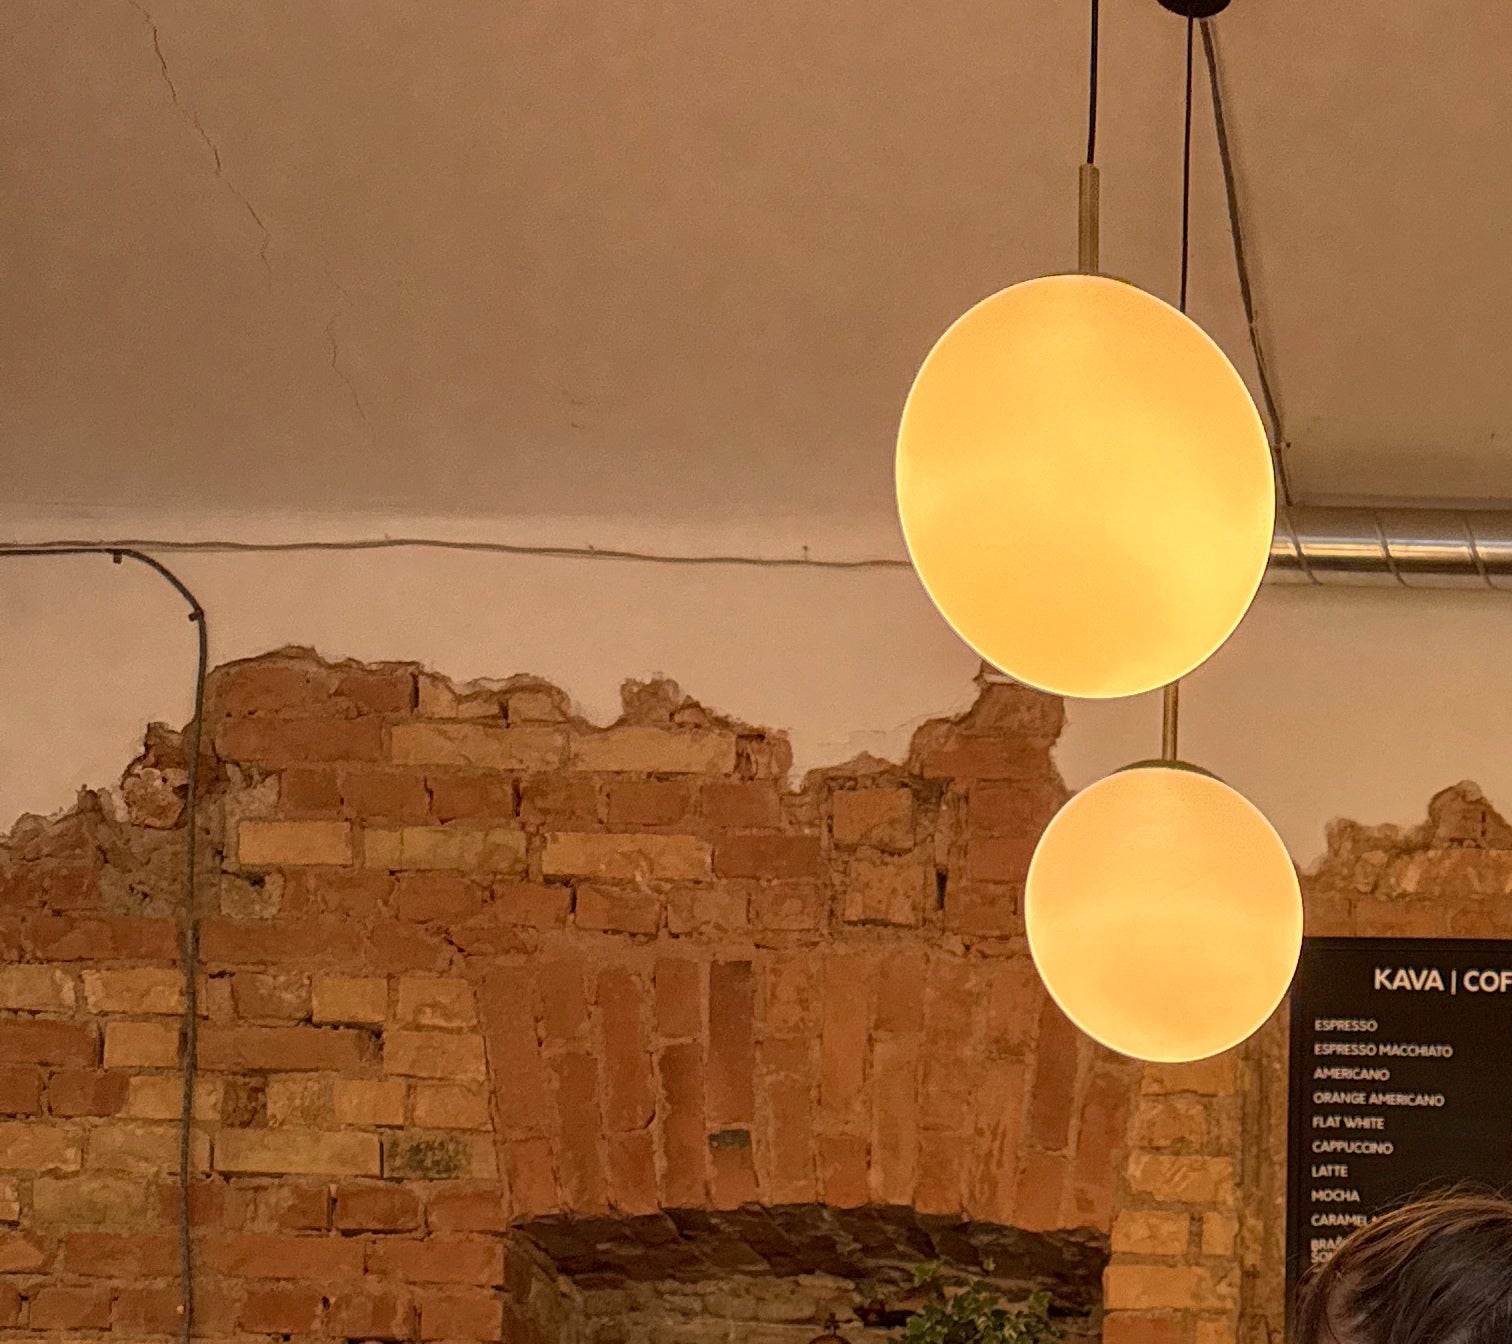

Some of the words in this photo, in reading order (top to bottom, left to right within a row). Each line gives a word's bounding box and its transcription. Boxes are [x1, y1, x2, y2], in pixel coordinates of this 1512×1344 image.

[1374, 969, 1444, 991] KAVA
[1315, 1019, 1377, 1032] ESPRESSO
[1314, 1044, 1377, 1057] ESPRESSO
[1379, 1045, 1453, 1058] MACCHIATO
[1313, 1068, 1390, 1081] AMERICANO
[1313, 1093, 1366, 1105] ORANGE
[1368, 1094, 1444, 1107] AMERICANO
[1313, 1117, 1340, 1129] FLAT
[1344, 1117, 1384, 1129] WHITE
[1312, 1142, 1393, 1155] CAPPUCCINO
[1312, 1165, 1348, 1177] LATTE
[1312, 1190, 1360, 1202] MOCHA
